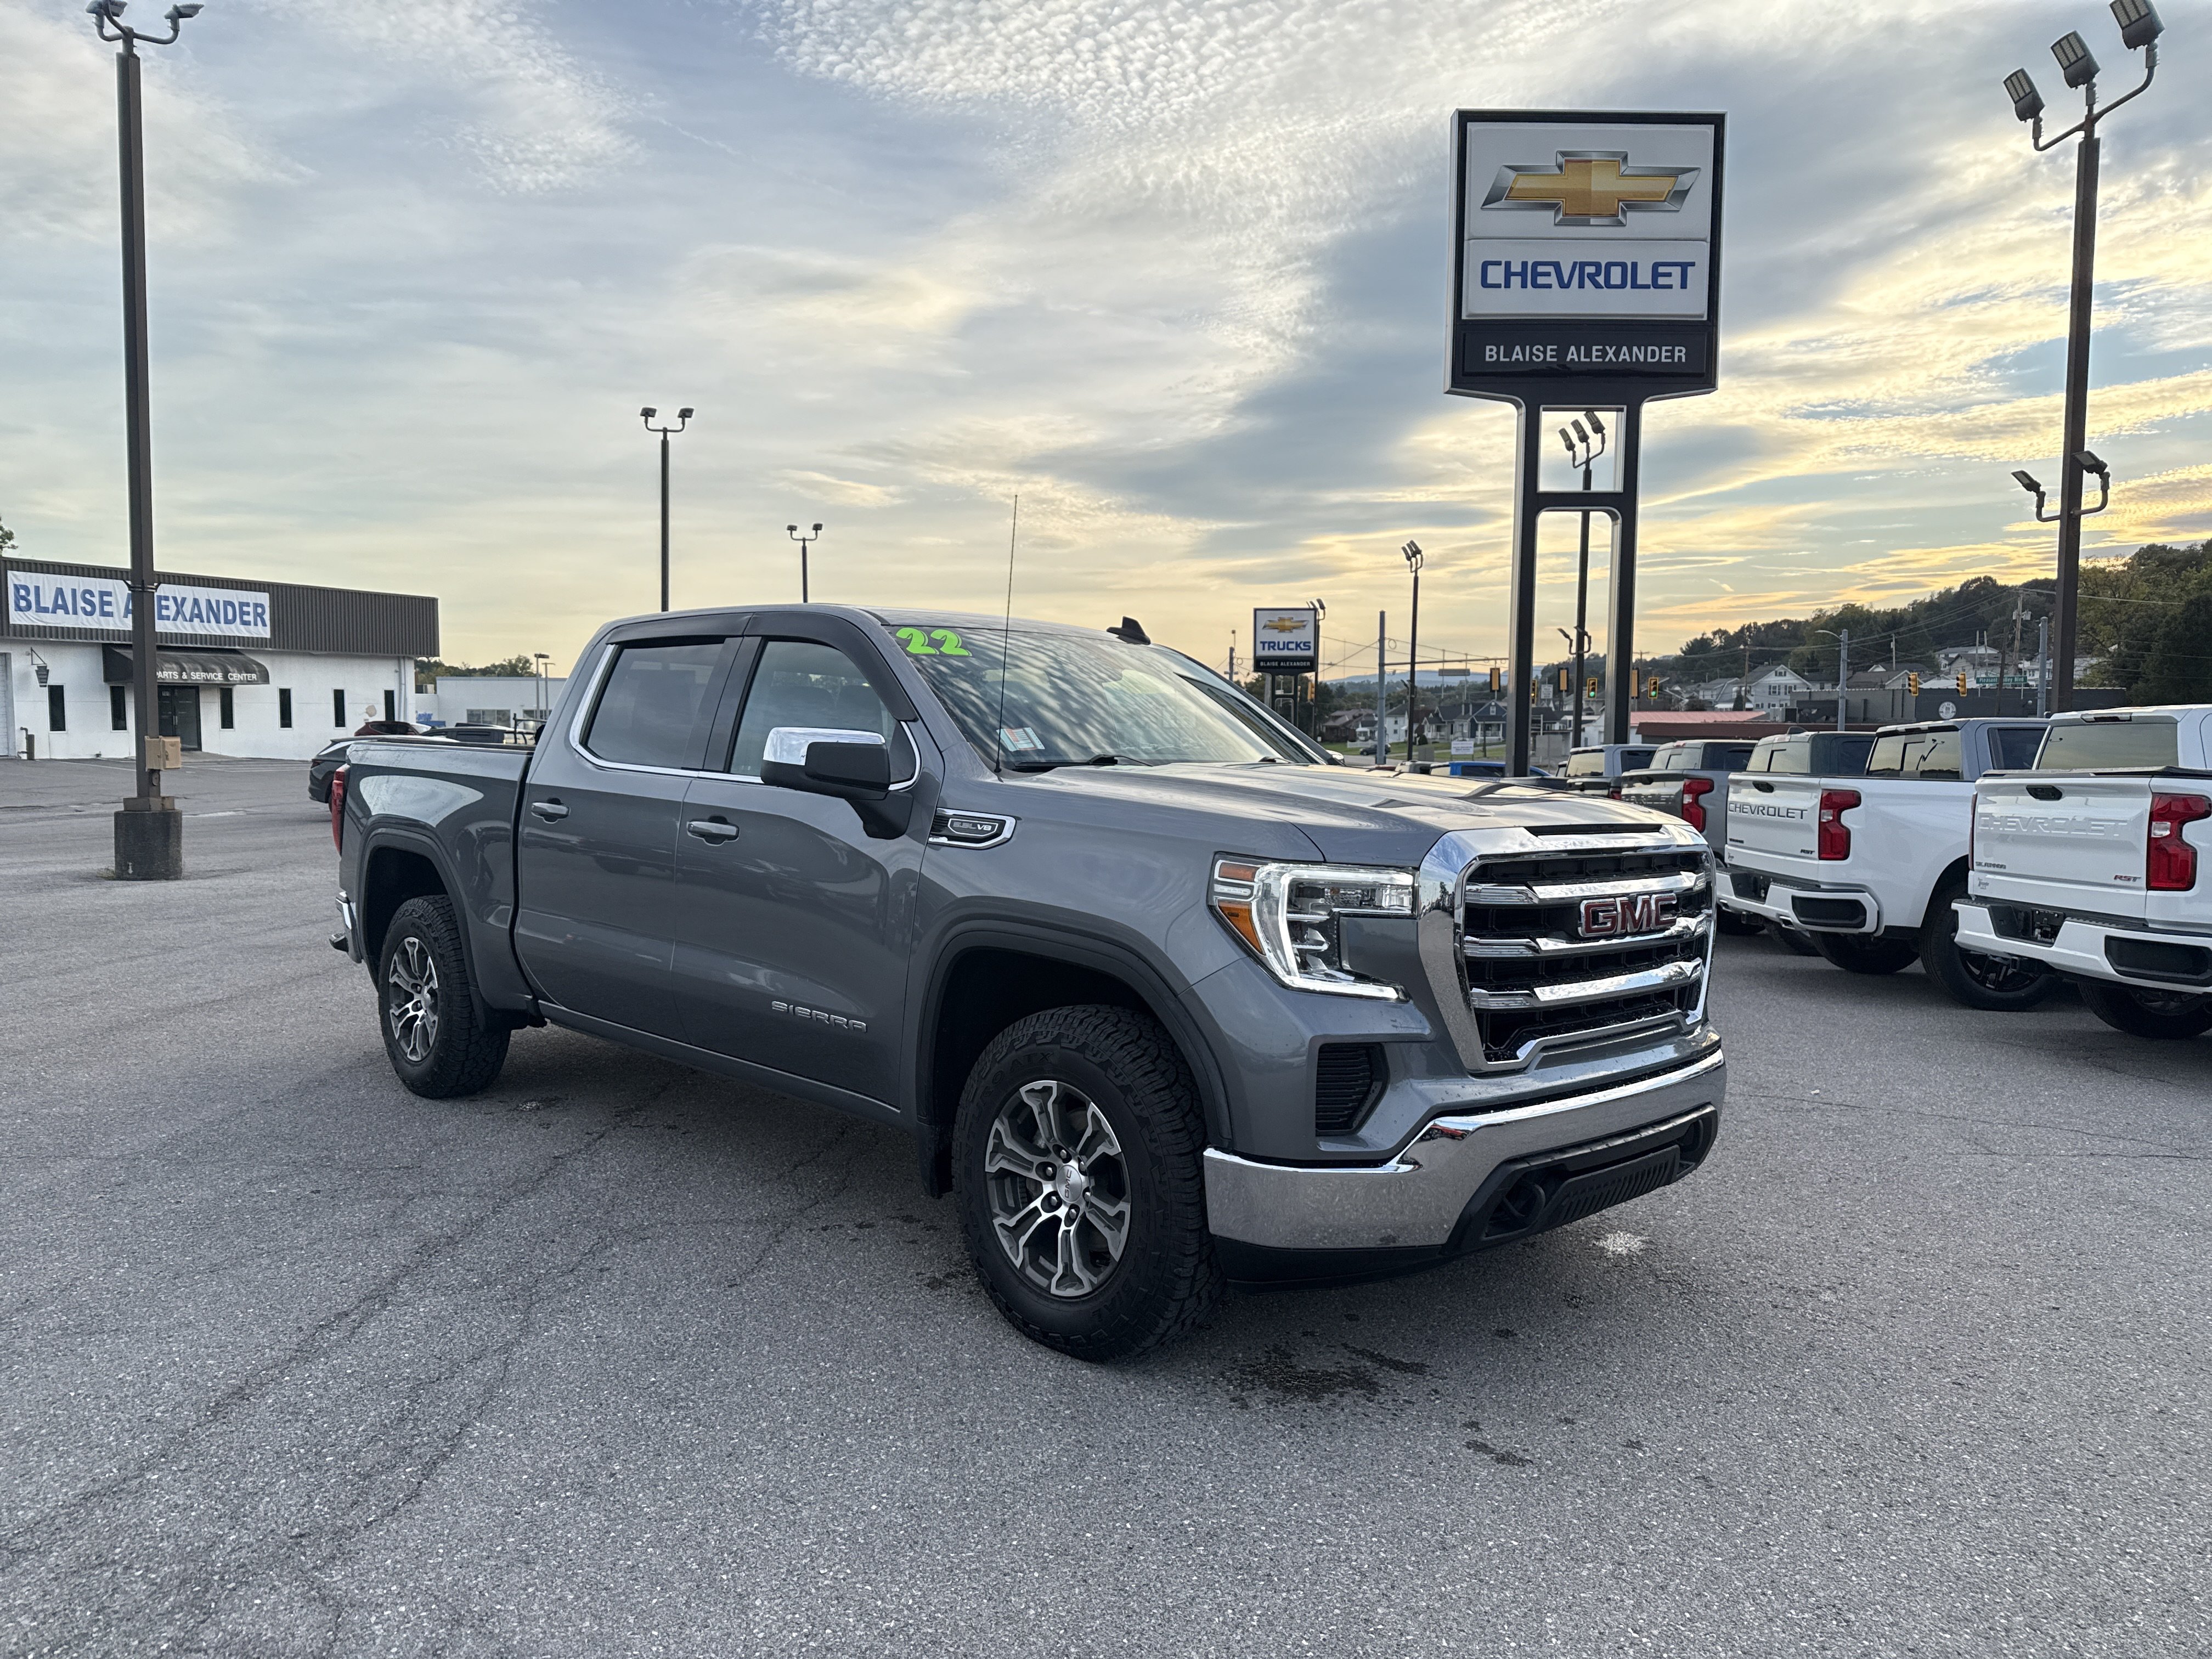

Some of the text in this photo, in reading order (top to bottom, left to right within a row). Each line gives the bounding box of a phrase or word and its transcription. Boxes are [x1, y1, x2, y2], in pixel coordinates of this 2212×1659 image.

[1481, 260, 1695, 289] CHEVROLET
[1485, 345, 1686, 363] BLAISE ALEXANDER
[13, 583, 267, 627] BLAISE AEXANDER
[896, 627, 973, 657] 22
[1260, 641, 1311, 651] TRUCKS
[182, 671, 188, 680] &
[190, 672, 223, 681] SERVICE
[228, 673, 257, 681] CENTER
[1729, 803, 1808, 819] CHEVROLET
[1578, 893, 1677, 938] GMC
[771, 1000, 868, 1033] SIERRA
[1064, 1169, 1073, 1199] GMC
